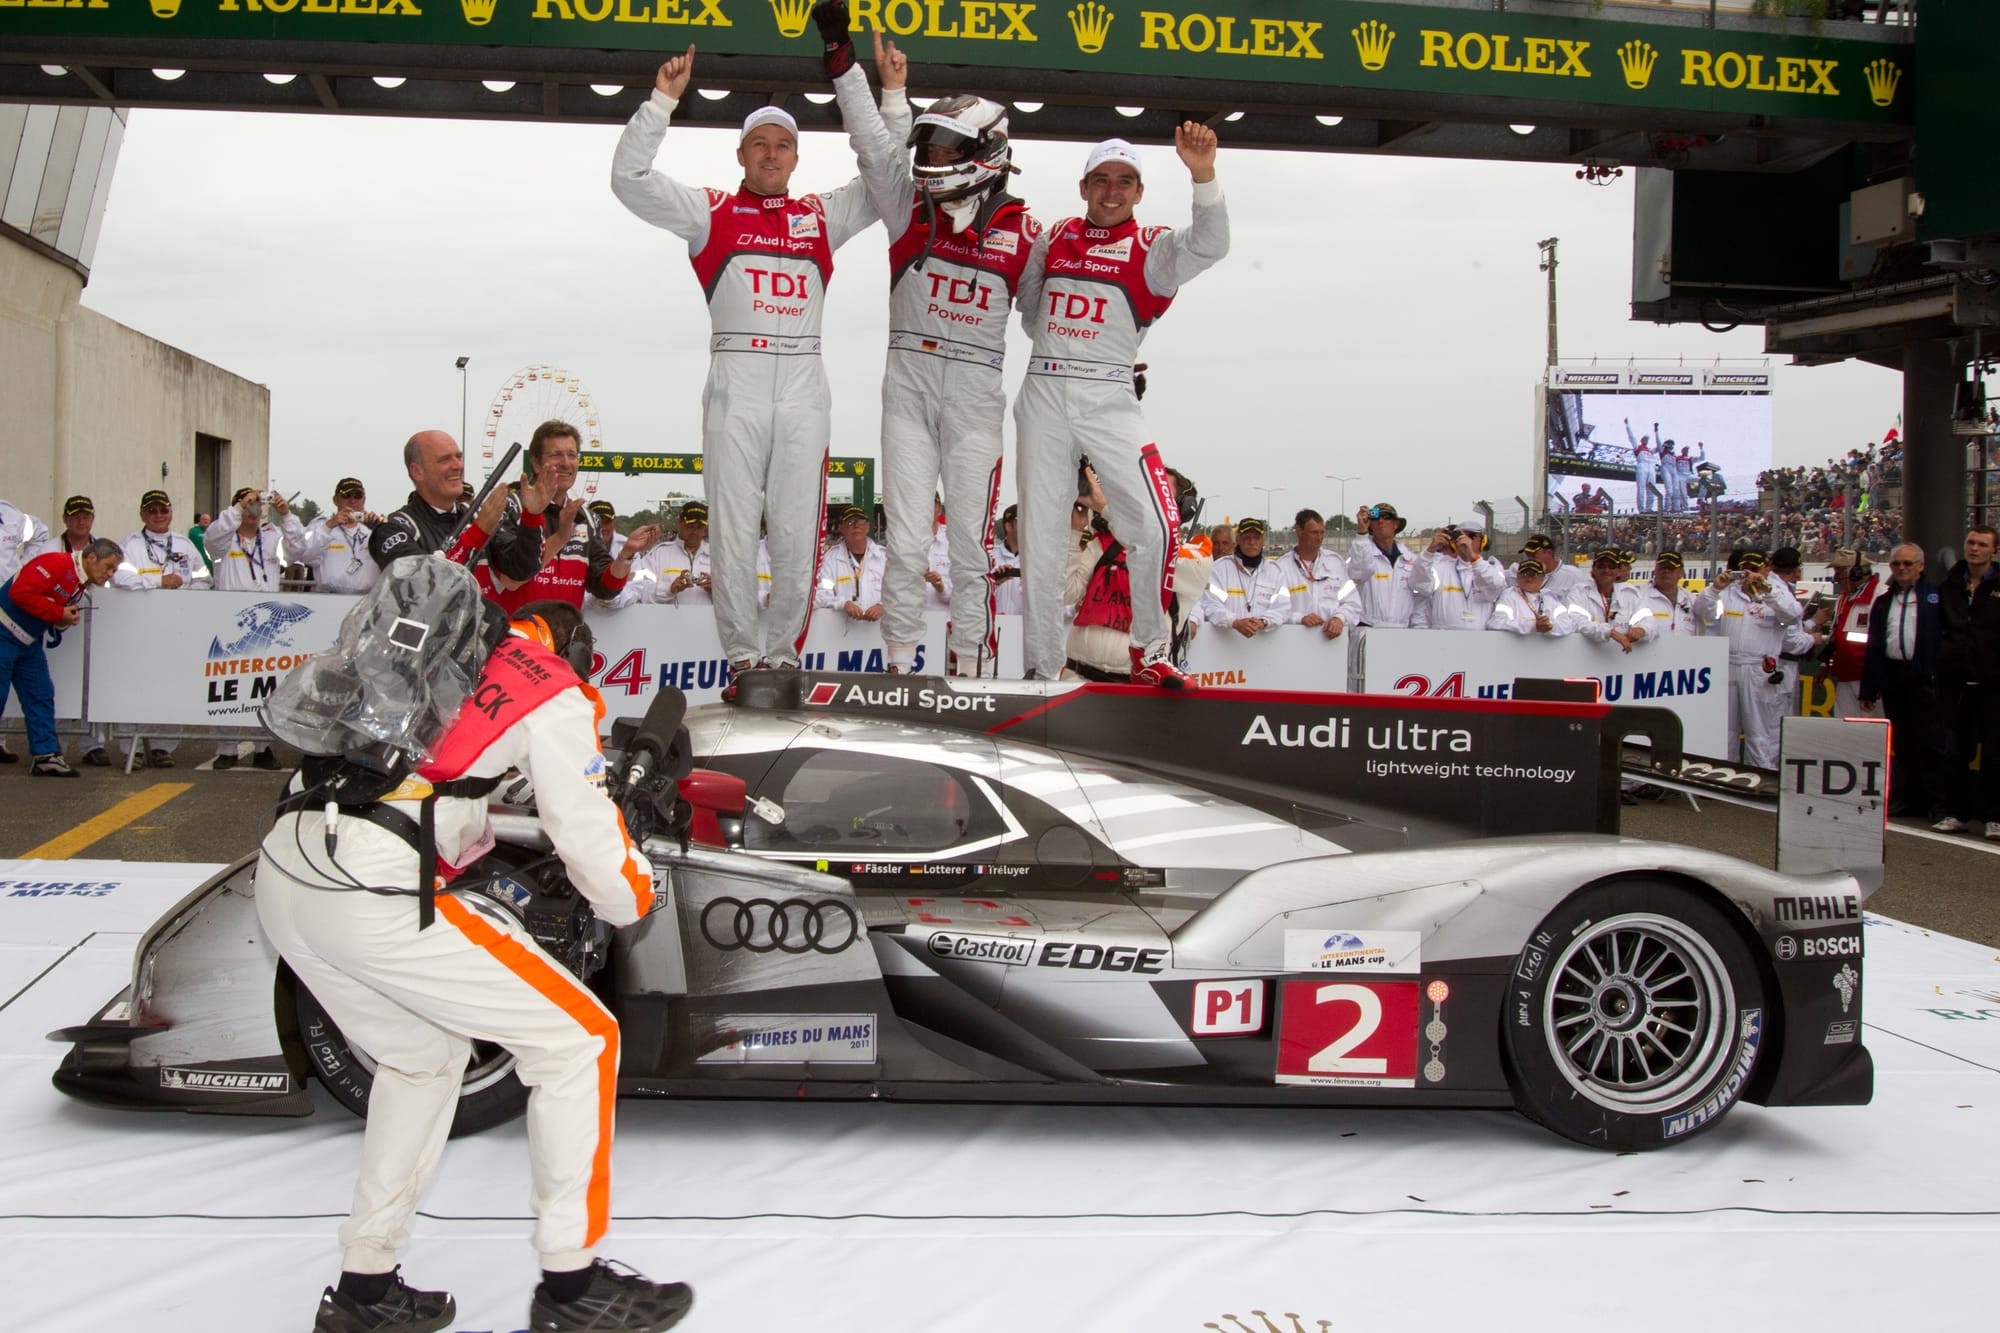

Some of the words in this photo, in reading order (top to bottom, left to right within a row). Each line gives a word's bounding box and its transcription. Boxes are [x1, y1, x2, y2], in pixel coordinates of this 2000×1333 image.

[1140, 11, 1324, 60] ROLEX
[1420, 29, 1591, 77] ROLEX
[1680, 49, 1839, 96] ROLEX
[753, 234, 784, 247] Audi
[787, 239, 814, 252] Sport
[942, 241, 968, 255] Audi
[972, 247, 1006, 263] Sport
[1063, 259, 1082, 270] Audi
[1084, 260, 1121, 274] Sport
[744, 267, 809, 299] TDI
[927, 272, 993, 311] TDI
[752, 300, 805, 317] Power
[927, 303, 984, 327] Power
[1048, 291, 1108, 324] TDI
[1048, 321, 1100, 340] Power
[1567, 374, 1617, 383] MICHELIN
[1641, 375, 1691, 384] MICHELIN
[1715, 376, 1767, 384] MICHELIN
[632, 456, 684, 469] ROLEX
[508, 648, 552, 680] MANS
[837, 644, 926, 673] MAS
[521, 669, 541, 686] 2011
[1632, 667, 1711, 700] MANS
[208, 679, 239, 703] LE
[844, 684, 909, 707] Audi
[918, 689, 996, 714] Sport
[1241, 714, 1351, 749] Audi
[1367, 719, 1472, 752] ultra
[1366, 759, 1470, 777] lightweight
[1475, 763, 1576, 783] technology
[1785, 758, 1882, 796] TDI
[865, 863, 902, 875] Fässler
[923, 864, 966, 875] Lotterer
[988, 864, 1030, 877] Tréluyer
[1773, 895, 1859, 921] MAHLE
[953, 937, 1024, 961] Castrol
[1037, 942, 1171, 974] EDGE
[1320, 947, 1387, 960] INTERCONTINENTAL
[1803, 936, 1861, 956] BOSCH
[1321, 959, 1331, 968] LE
[1335, 956, 1365, 967] MANS
[1367, 956, 1384, 965] cup
[1206, 987, 1253, 1027] P1
[743, 1029, 798, 1048] HEURES
[802, 1028, 822, 1043] DU
[827, 1024, 871, 1042] MANS
[1308, 983, 1388, 1074] 2
[850, 1040, 870, 1049] 2011
[186, 1072, 283, 1089] MICHELIN
[1309, 1076, 1382, 1087] www.lemans.org
[1667, 1038, 1756, 1136] MICHELIN
